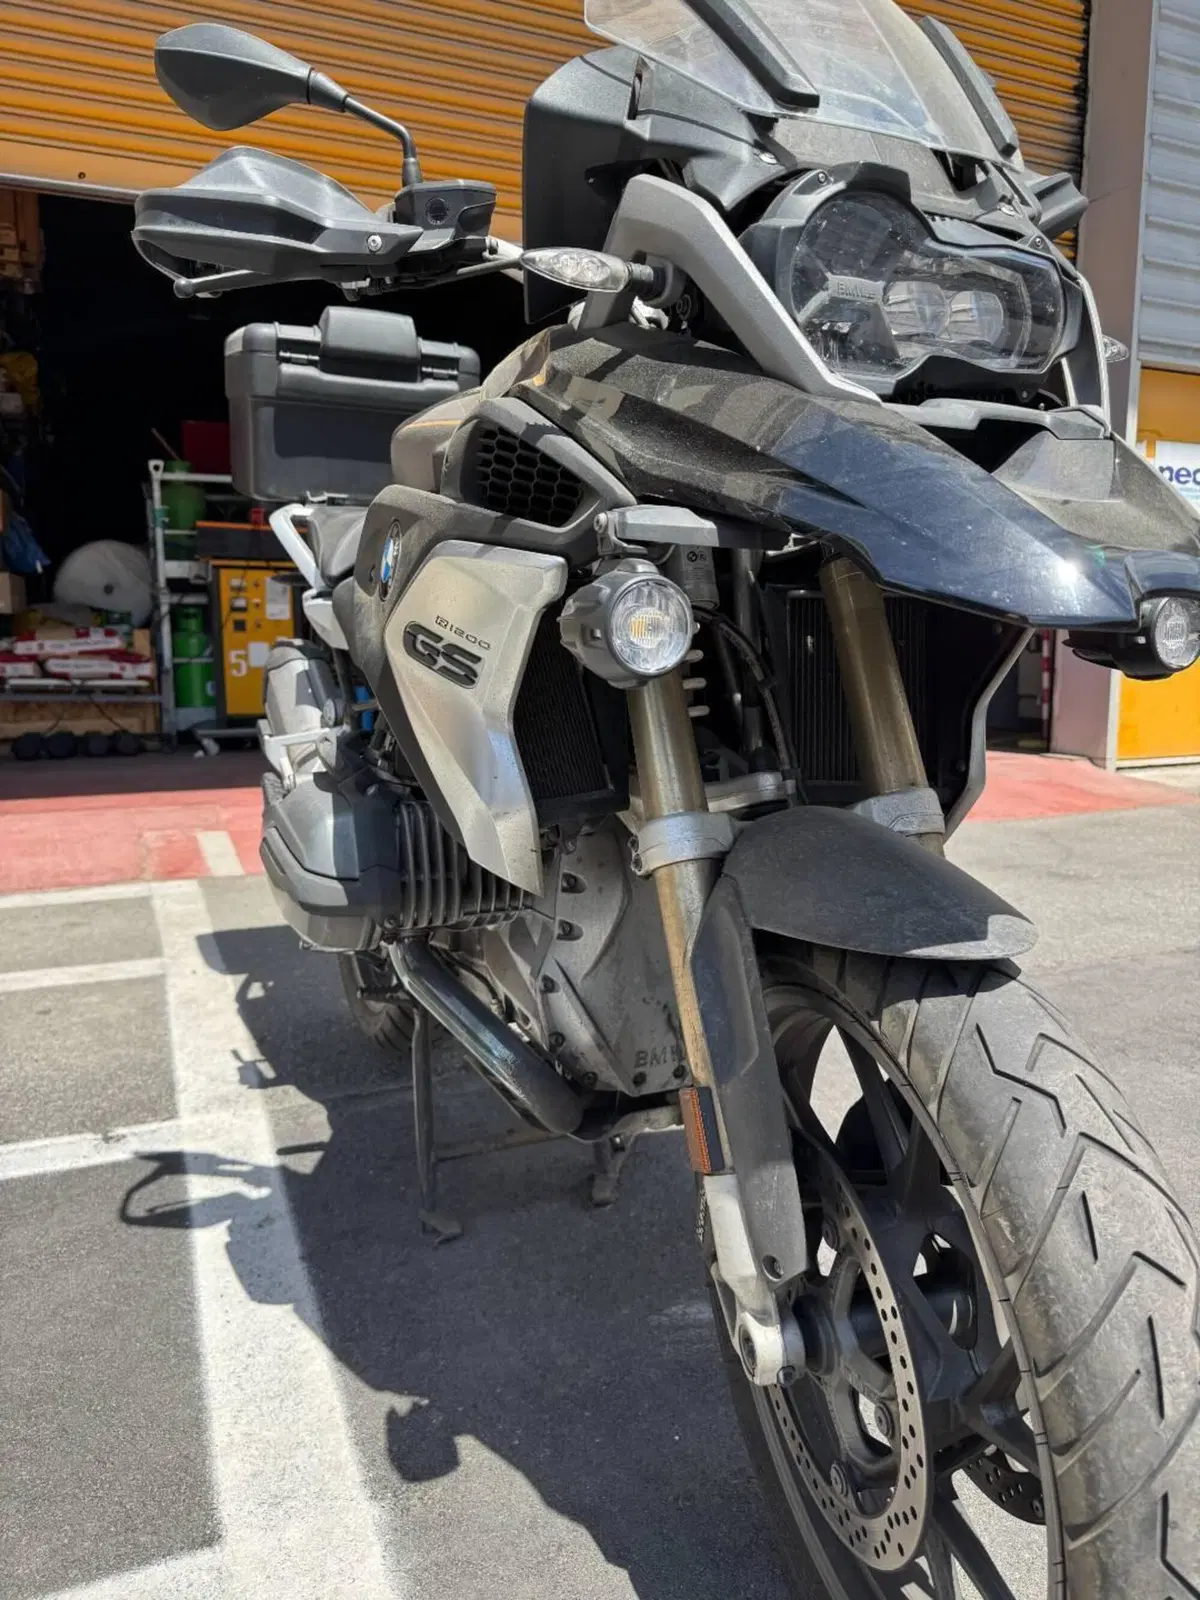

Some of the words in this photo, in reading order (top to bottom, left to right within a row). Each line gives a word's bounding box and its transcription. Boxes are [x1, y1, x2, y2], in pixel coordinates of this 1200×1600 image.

[434, 615, 491, 651] R1200
[229, 649, 248, 677] 5
[403, 622, 483, 688] GS
